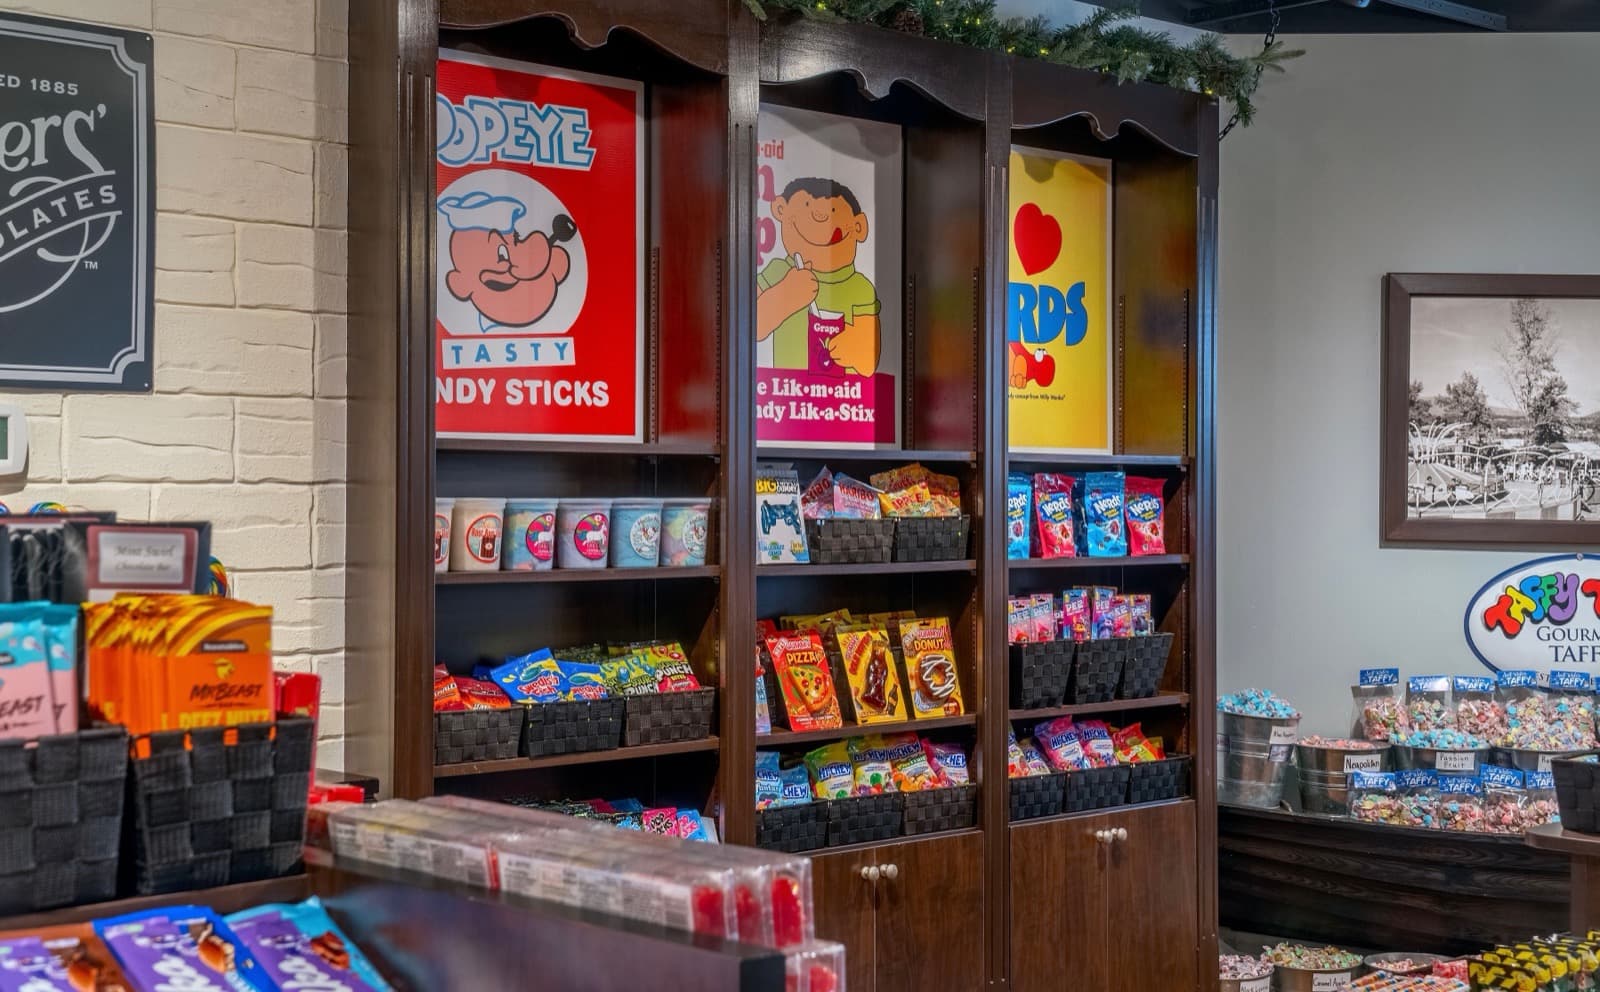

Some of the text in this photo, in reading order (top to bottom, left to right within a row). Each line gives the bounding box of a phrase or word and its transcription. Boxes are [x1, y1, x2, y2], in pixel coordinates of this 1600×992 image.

[30, 78, 79, 95] 1885
[0, 184, 117, 249] LATES
[813, 322, 840, 335] Grape
[451, 342, 568, 365] TASTY
[505, 378, 610, 407] STICKS
[756, 478, 777, 494] BIG
[801, 478, 831, 506] ARIBO
[839, 482, 875, 501] HARIBO
[1484, 571, 1580, 640] TAFFY
[914, 639, 945, 651] DONUT
[786, 651, 818, 665] PIZZA
[654, 662, 694, 681] PUNCH
[1367, 674, 1394, 683] TAFFY
[517, 676, 559, 695] Swedish
[1463, 681, 1490, 691] TAFFY
[1506, 676, 1532, 685] TAFFY
[1559, 676, 1585, 686] TAFFY
[1363, 777, 1390, 786] TAFFY
[1405, 775, 1433, 785] TAFFY
[1488, 773, 1517, 783] TAFFY
[1447, 783, 1476, 793] TAFFY
